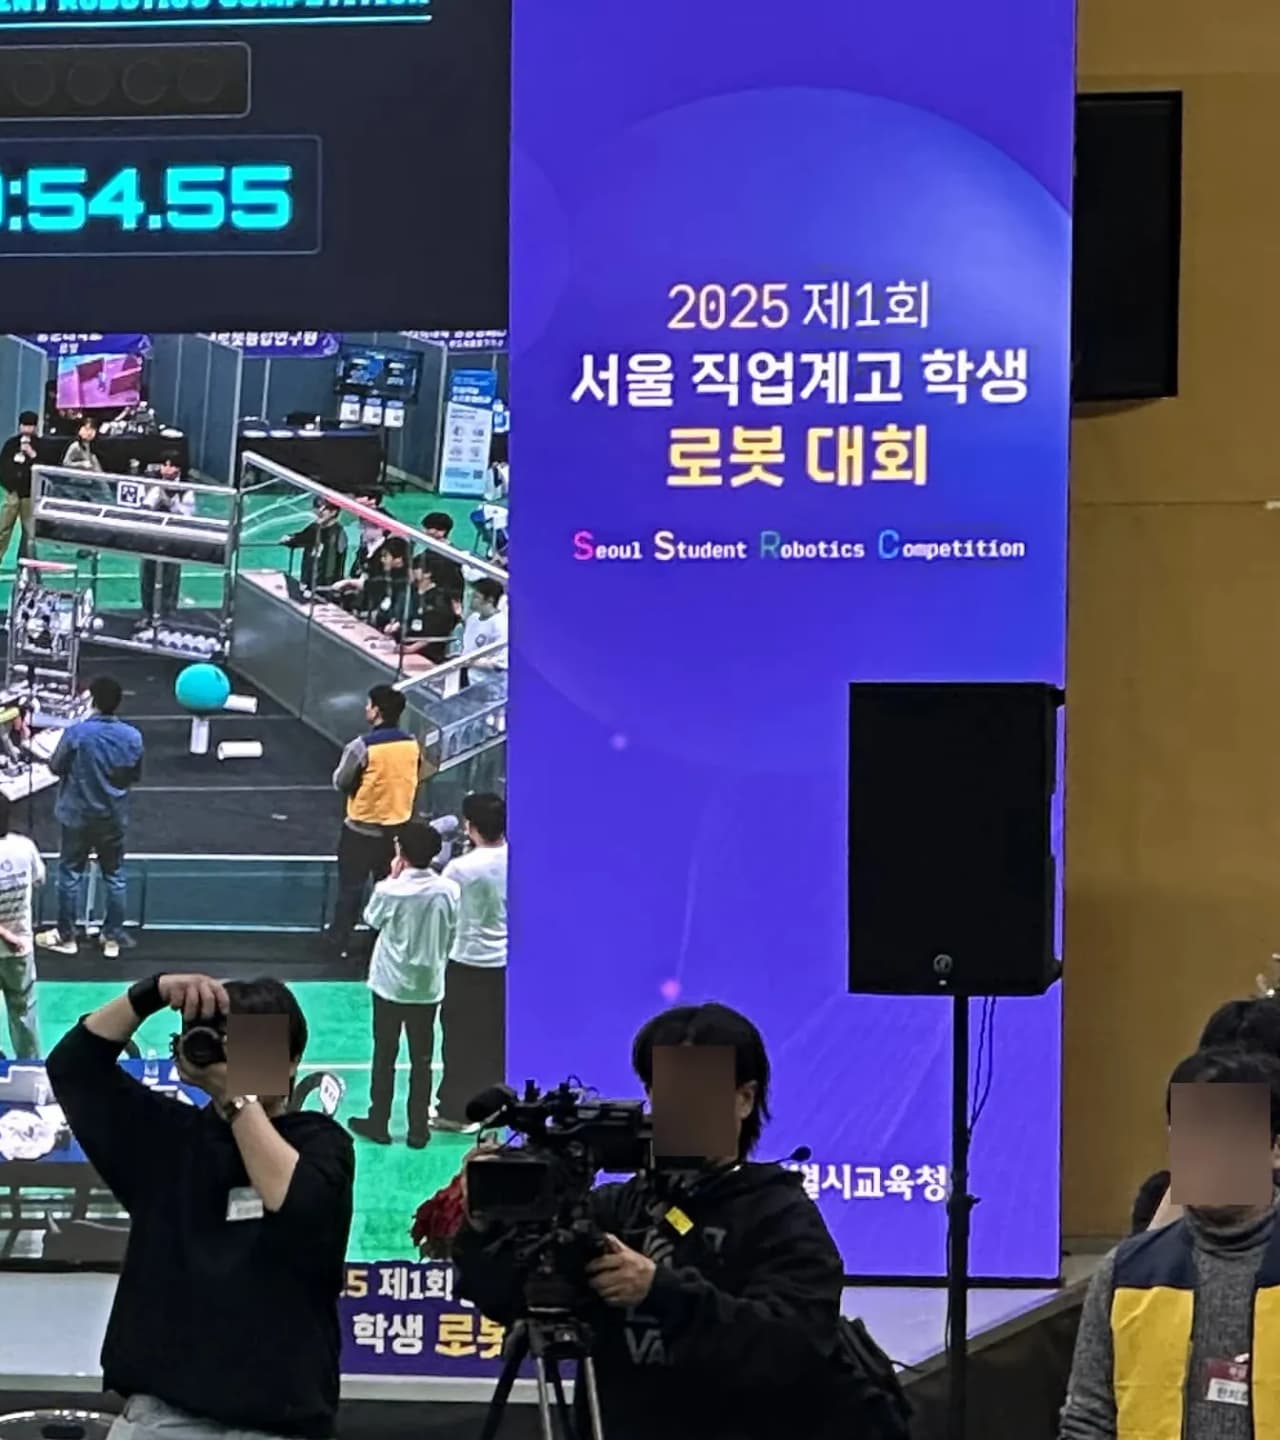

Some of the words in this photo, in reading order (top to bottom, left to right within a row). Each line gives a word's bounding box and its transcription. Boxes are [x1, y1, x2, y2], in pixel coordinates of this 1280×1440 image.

[667, 283, 789, 329] 2025
[802, 280, 929, 330] 제1회
[571, 352, 675, 407] 서울
[691, 350, 903, 406] 직업계고
[920, 348, 1028, 404] 학생
[666, 425, 786, 487] 로봇
[807, 424, 928, 486] 대회
[573, 530, 643, 560] Seoul
[653, 530, 747, 560] Student
[760, 530, 865, 560] Robotics
[878, 529, 1026, 562] Competition
[377, 1267, 453, 1301] 제1회
[352, 1313, 424, 1355] 학생
